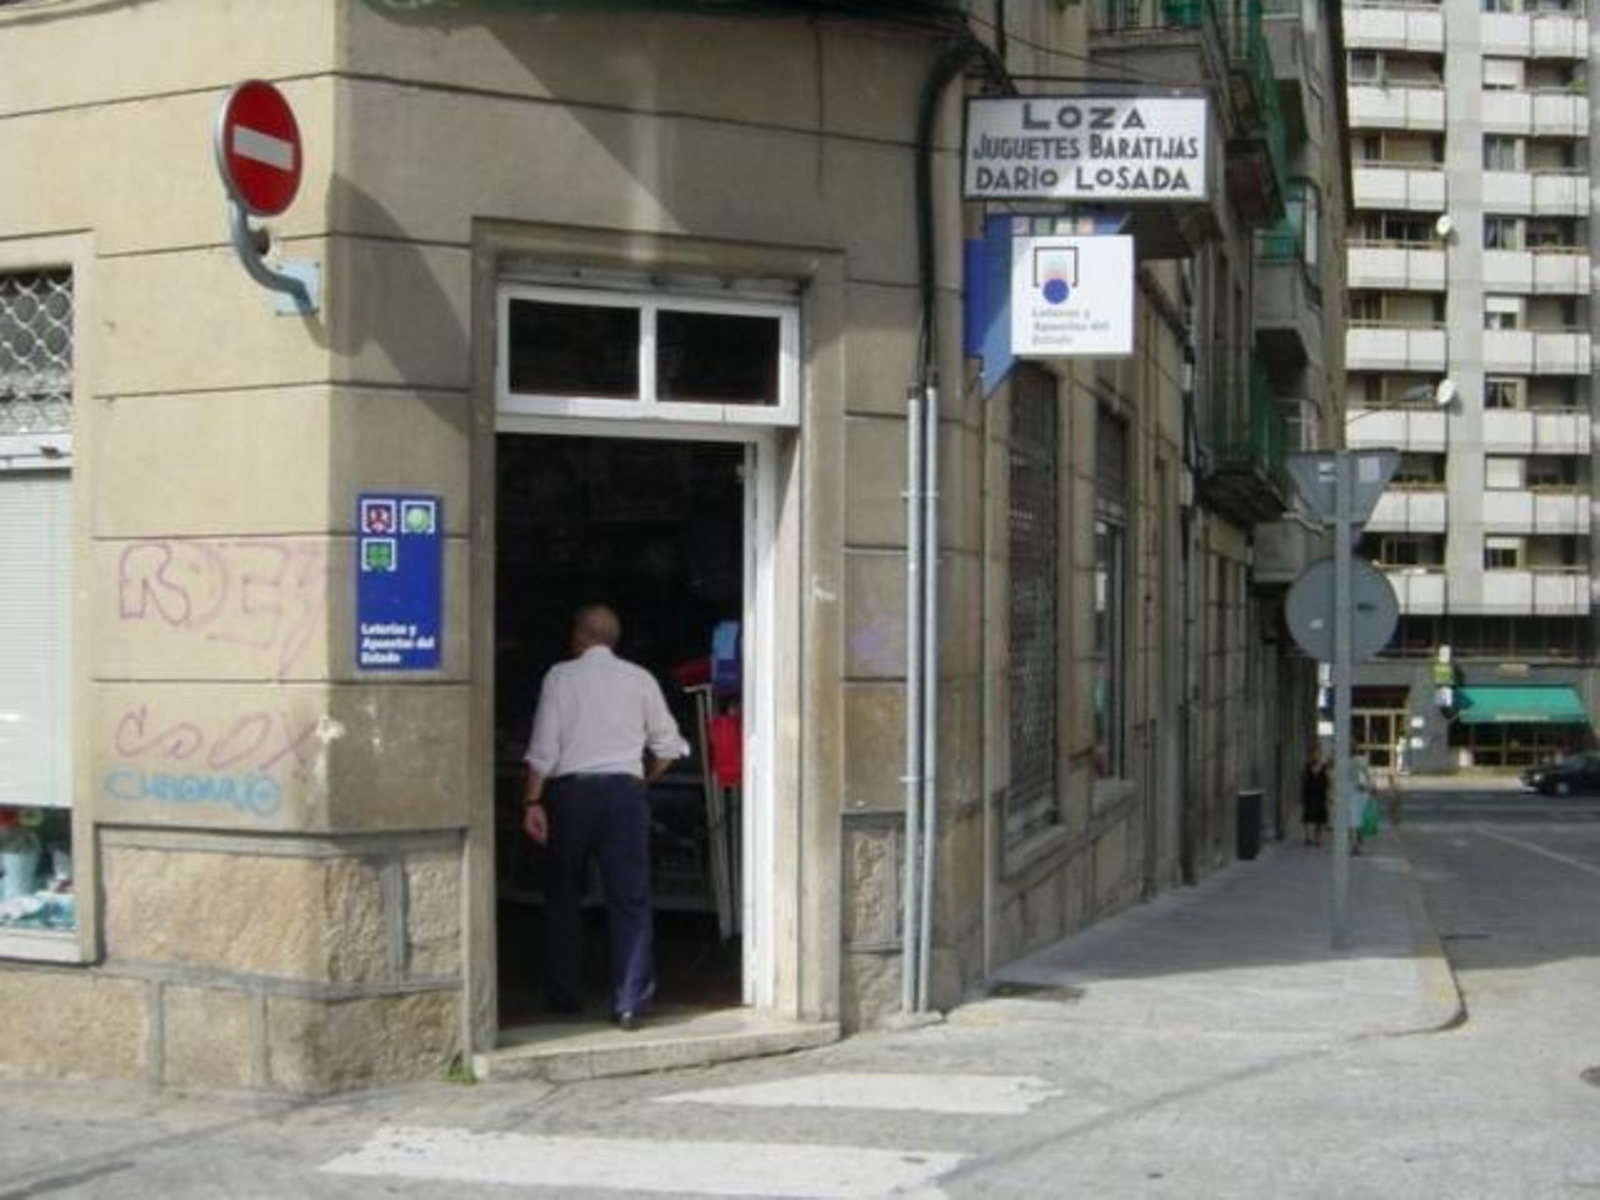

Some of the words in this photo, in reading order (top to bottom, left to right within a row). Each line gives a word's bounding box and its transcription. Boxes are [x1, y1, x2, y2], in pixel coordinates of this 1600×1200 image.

[1022, 102, 1146, 130] LOZA
[972, 133, 1081, 160] JUGUETES
[1089, 133, 1199, 160] BARATIJAS
[976, 165, 1060, 191] DARIO
[1076, 165, 1190, 191] LOSADA
